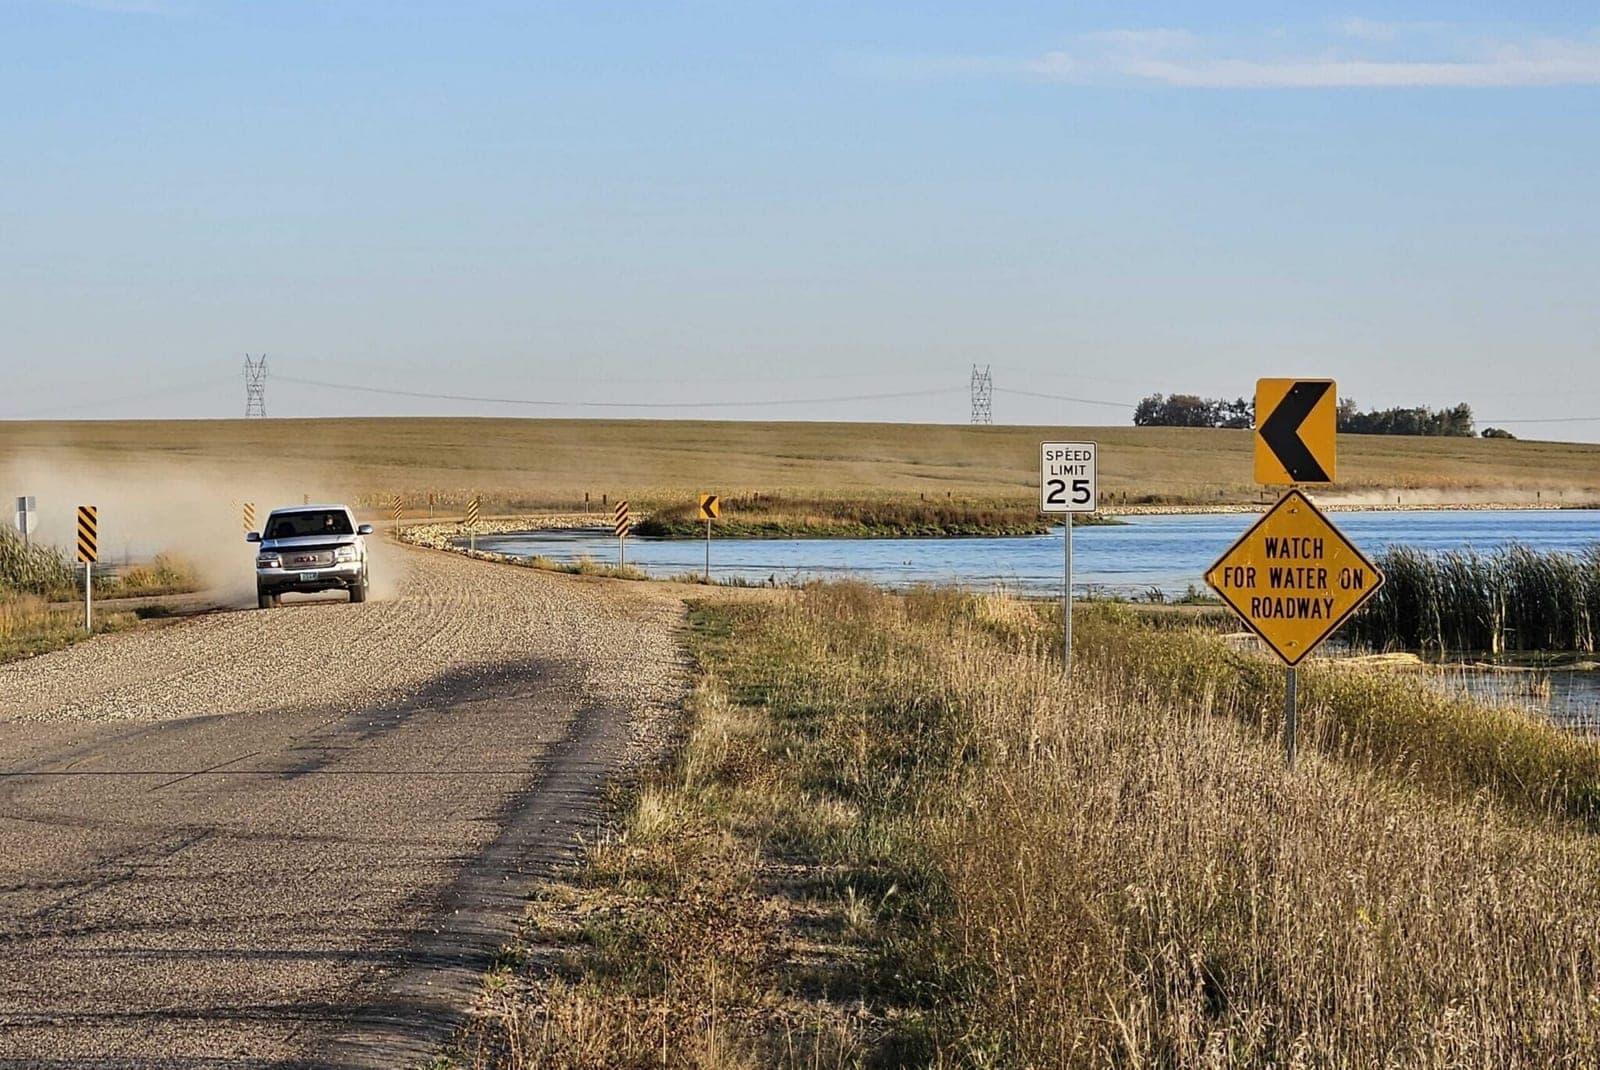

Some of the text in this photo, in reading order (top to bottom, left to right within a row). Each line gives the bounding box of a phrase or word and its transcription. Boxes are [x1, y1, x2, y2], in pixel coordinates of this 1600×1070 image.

[1046, 450, 1092, 461] SPEED
[1050, 465, 1087, 476] LIMIT
[1046, 479, 1091, 504] 25
[1264, 537, 1324, 559] WATCH
[1224, 566, 1363, 590] FOR WATER ON
[1251, 596, 1335, 619] ROADWAY
